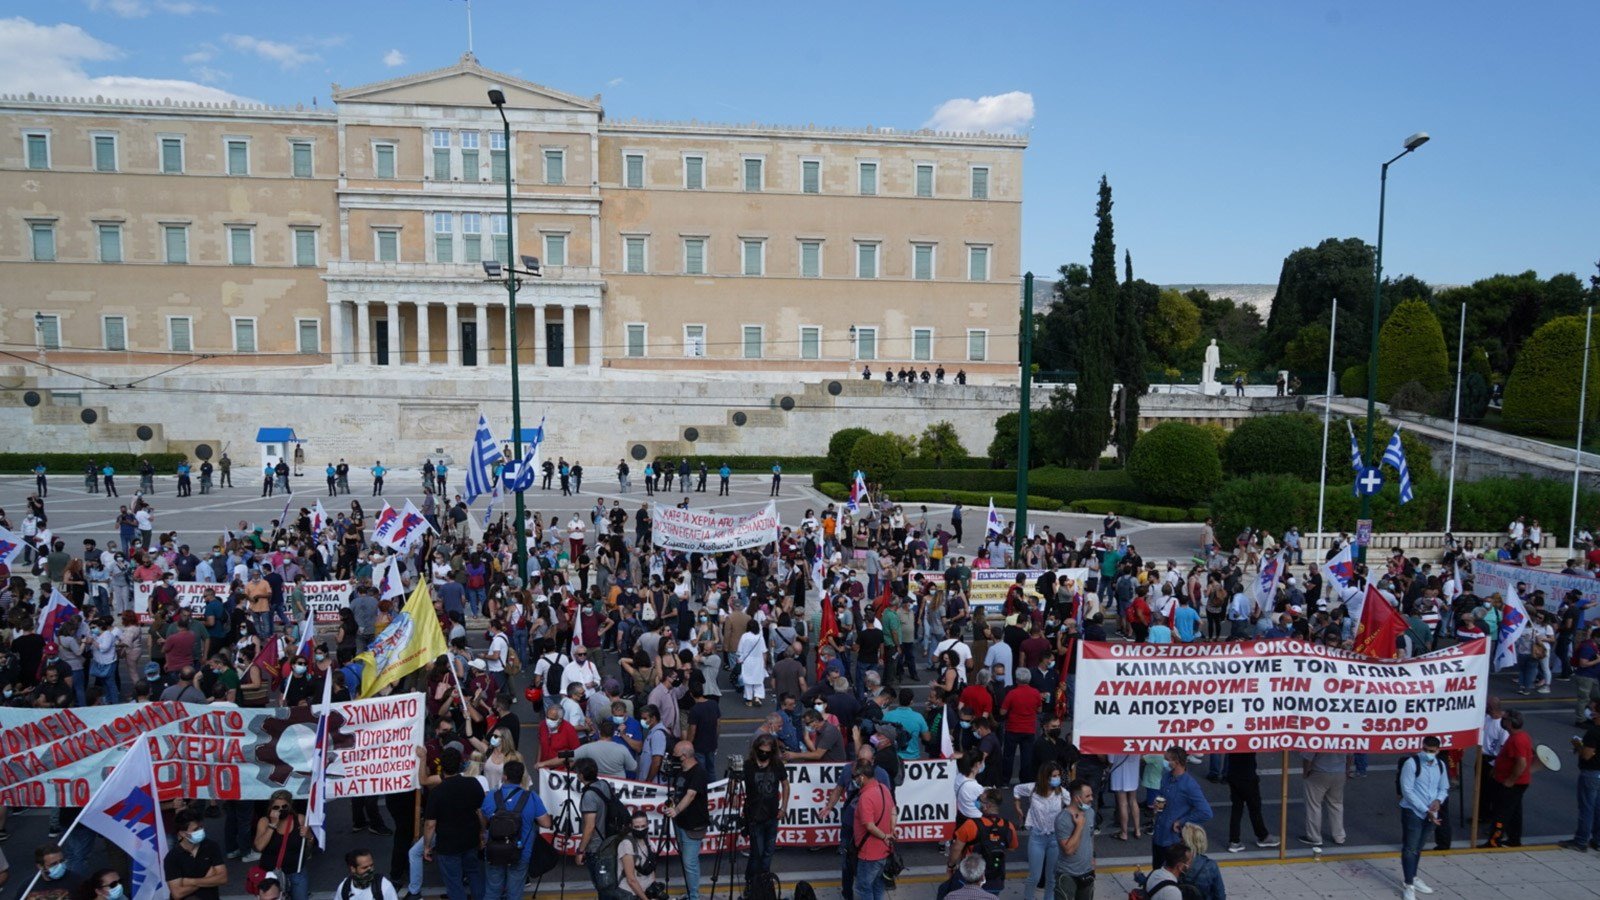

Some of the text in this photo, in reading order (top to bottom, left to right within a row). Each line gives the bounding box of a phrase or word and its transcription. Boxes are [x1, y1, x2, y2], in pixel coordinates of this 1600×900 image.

[990, 571, 1017, 579] ΜΟΡΦΩΣ
[1110, 643, 1243, 658] ΟΜΟΣΠΟΝΔΙΑ
[1116, 659, 1465, 678] ΚΛΙΜΑΚΩΝΟΥΜΕ ΤΟΝ ΑΓΩΝΑ ΜΑΣ
[1094, 675, 1478, 696] ΔΥΝΑΜΩΝΟΥΜΕ ΤΗΝ ΟΡΓΑΝΩΣΗ ΜΑΣ
[342, 698, 417, 726] ΣΥΝΔΙΚΑΤΟ
[1094, 695, 1476, 715] ΝΑ ΑΠΟΣΥΡΘΕΙ ΤΟ ΝΟΜΟΣΧΕΔΙΟ ΕΚΤΡΩΜΑ
[0, 708, 88, 757] ΟΥΛΕΙΑ
[1158, 718, 1215, 734] 7ΩΡΟ
[1244, 715, 1331, 732] 5ΗΜΕΡΟ
[1361, 716, 1429, 732] 35ΩΡΟ
[355, 727, 413, 747] ΤΟΥΡΙΣΜΟΥ
[1123, 735, 1453, 752] ΣΥΝΔΙΚΑΤΟ ΟΙΚΟΔΟΜΩΝ ΑΘΗΣ
[167, 734, 248, 764] ΧΕΡΙΑ
[342, 744, 413, 764] ΕΠΙΣΙΤΙΣΜΟΥ
[0, 751, 49, 786] ΑΤΑ
[344, 759, 416, 777] ΞΕΝΟΔΟΧΕΙΩΝ
[904, 762, 949, 781] ΟΥΣ
[52, 778, 90, 806] ΤΟ
